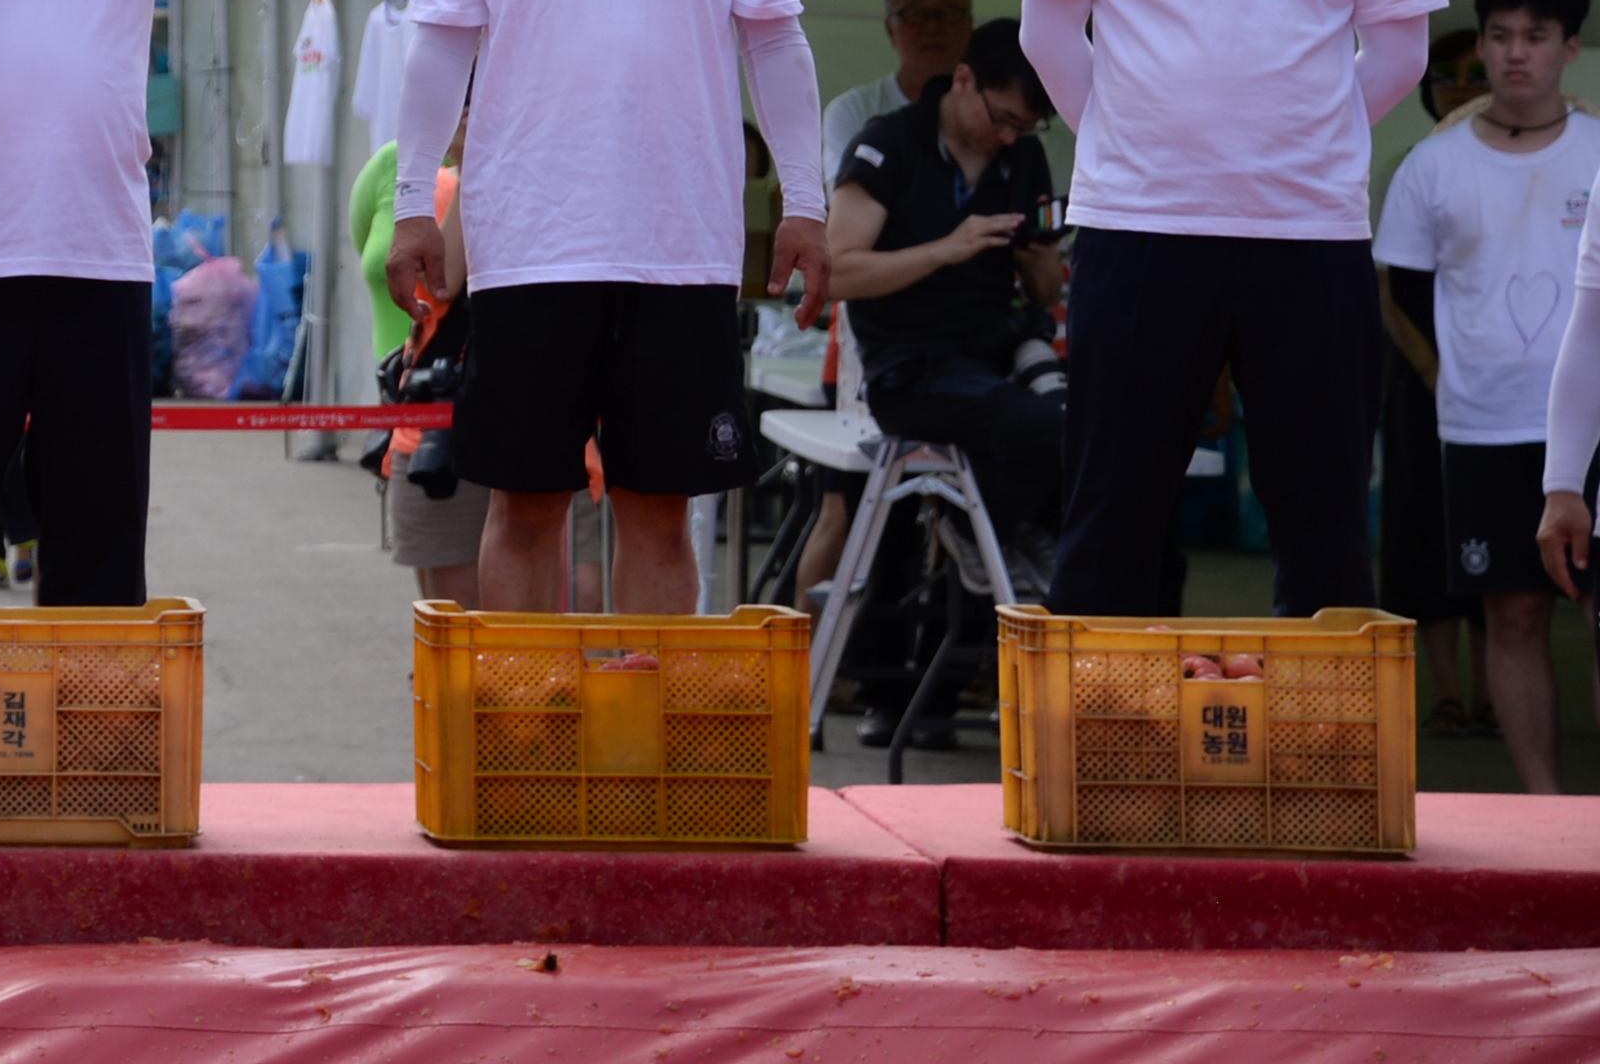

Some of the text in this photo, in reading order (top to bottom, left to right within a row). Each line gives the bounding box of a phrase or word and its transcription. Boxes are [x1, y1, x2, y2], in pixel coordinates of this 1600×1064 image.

[2, 691, 26, 748] 김재각
[1202, 705, 1247, 729] 대원
[1202, 732, 1248, 754] 농원
